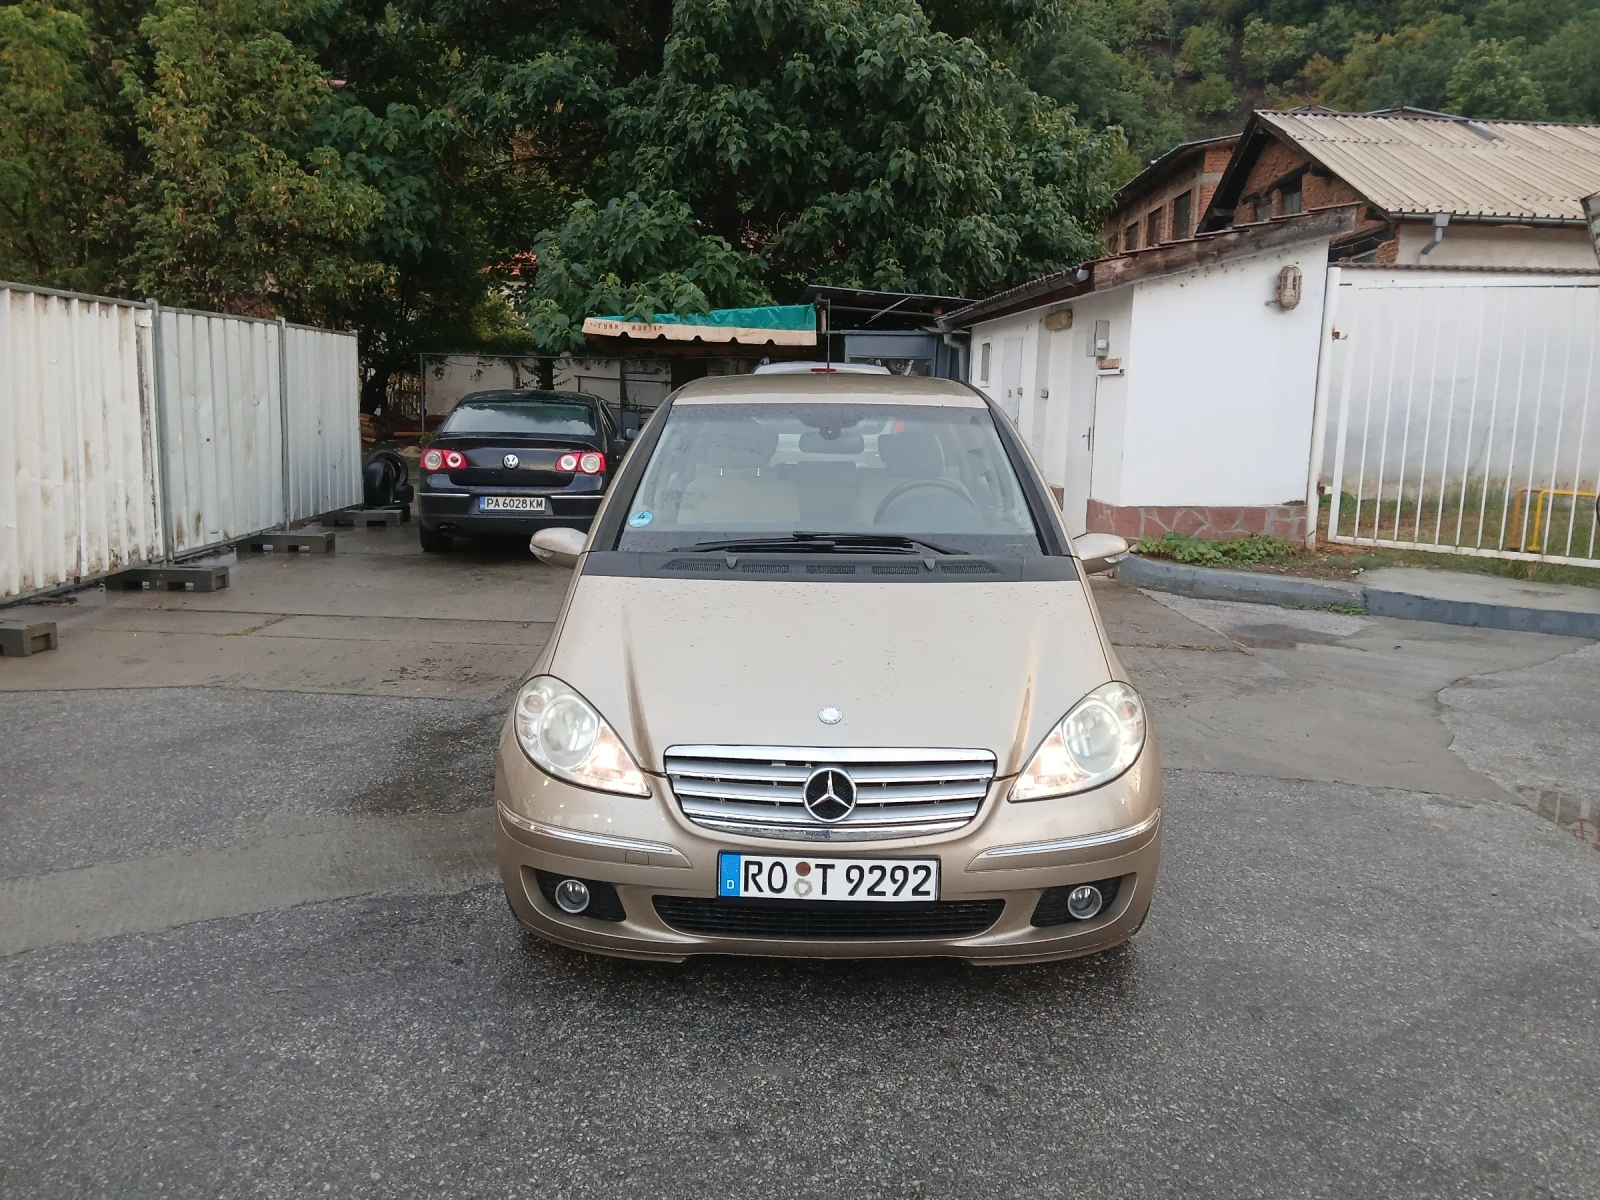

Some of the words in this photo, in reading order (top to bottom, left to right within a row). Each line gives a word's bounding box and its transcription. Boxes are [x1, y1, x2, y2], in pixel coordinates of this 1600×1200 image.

[486, 498, 500, 508] PA
[502, 498, 528, 509] 6028
[529, 499, 543, 509] KM
[743, 860, 788, 894] RO
[814, 863, 836, 896] T
[845, 864, 932, 897] 9292
[726, 879, 735, 890] D
